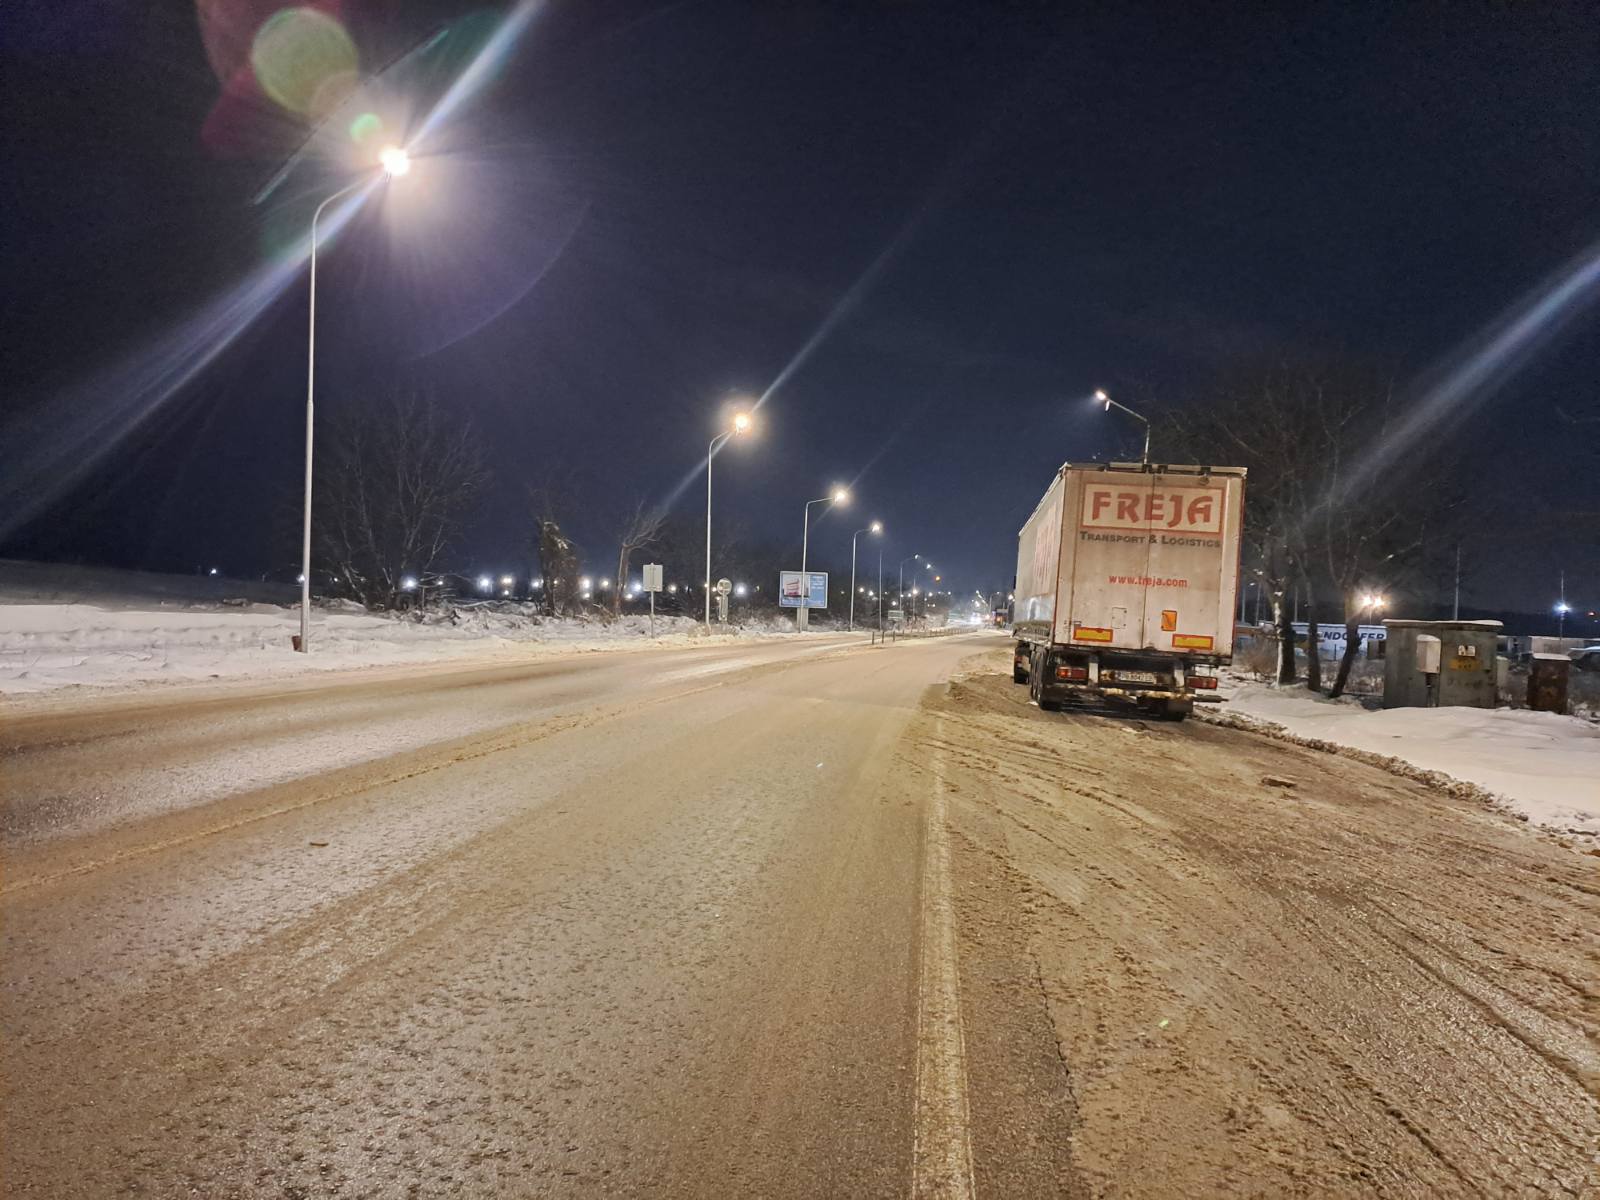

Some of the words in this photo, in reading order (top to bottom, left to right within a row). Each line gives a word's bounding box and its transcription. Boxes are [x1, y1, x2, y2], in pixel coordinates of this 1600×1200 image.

[1091, 491, 1213, 528] FREJA
[1148, 535, 1157, 544] &
[1109, 575, 1188, 588] www.freja.com
